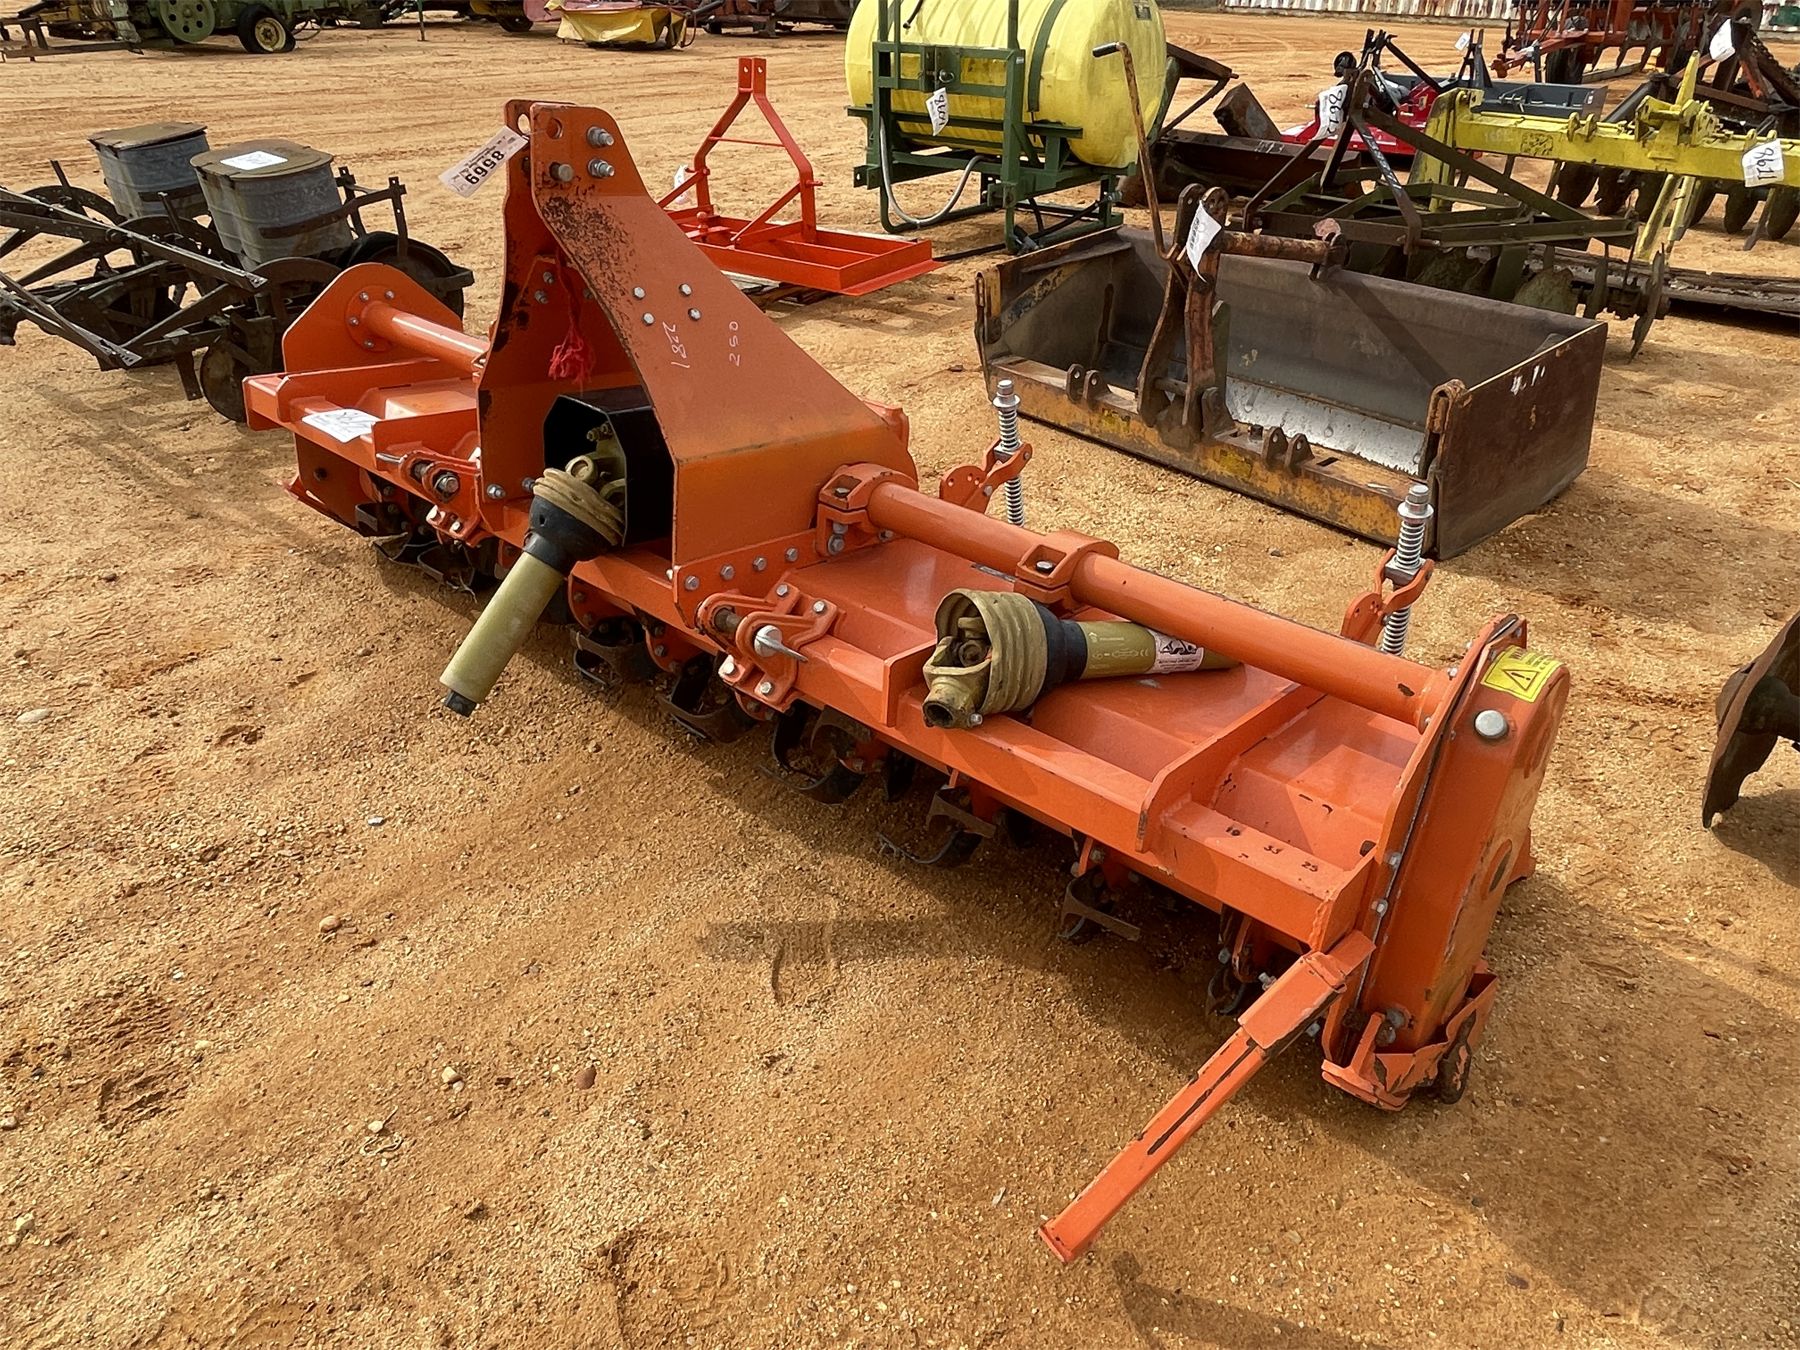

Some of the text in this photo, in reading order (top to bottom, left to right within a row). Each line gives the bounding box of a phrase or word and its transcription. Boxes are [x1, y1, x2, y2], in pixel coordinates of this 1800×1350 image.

[465, 150, 505, 184] 8569
[1754, 147, 1777, 180] 8611
[728, 320, 740, 367] 250
